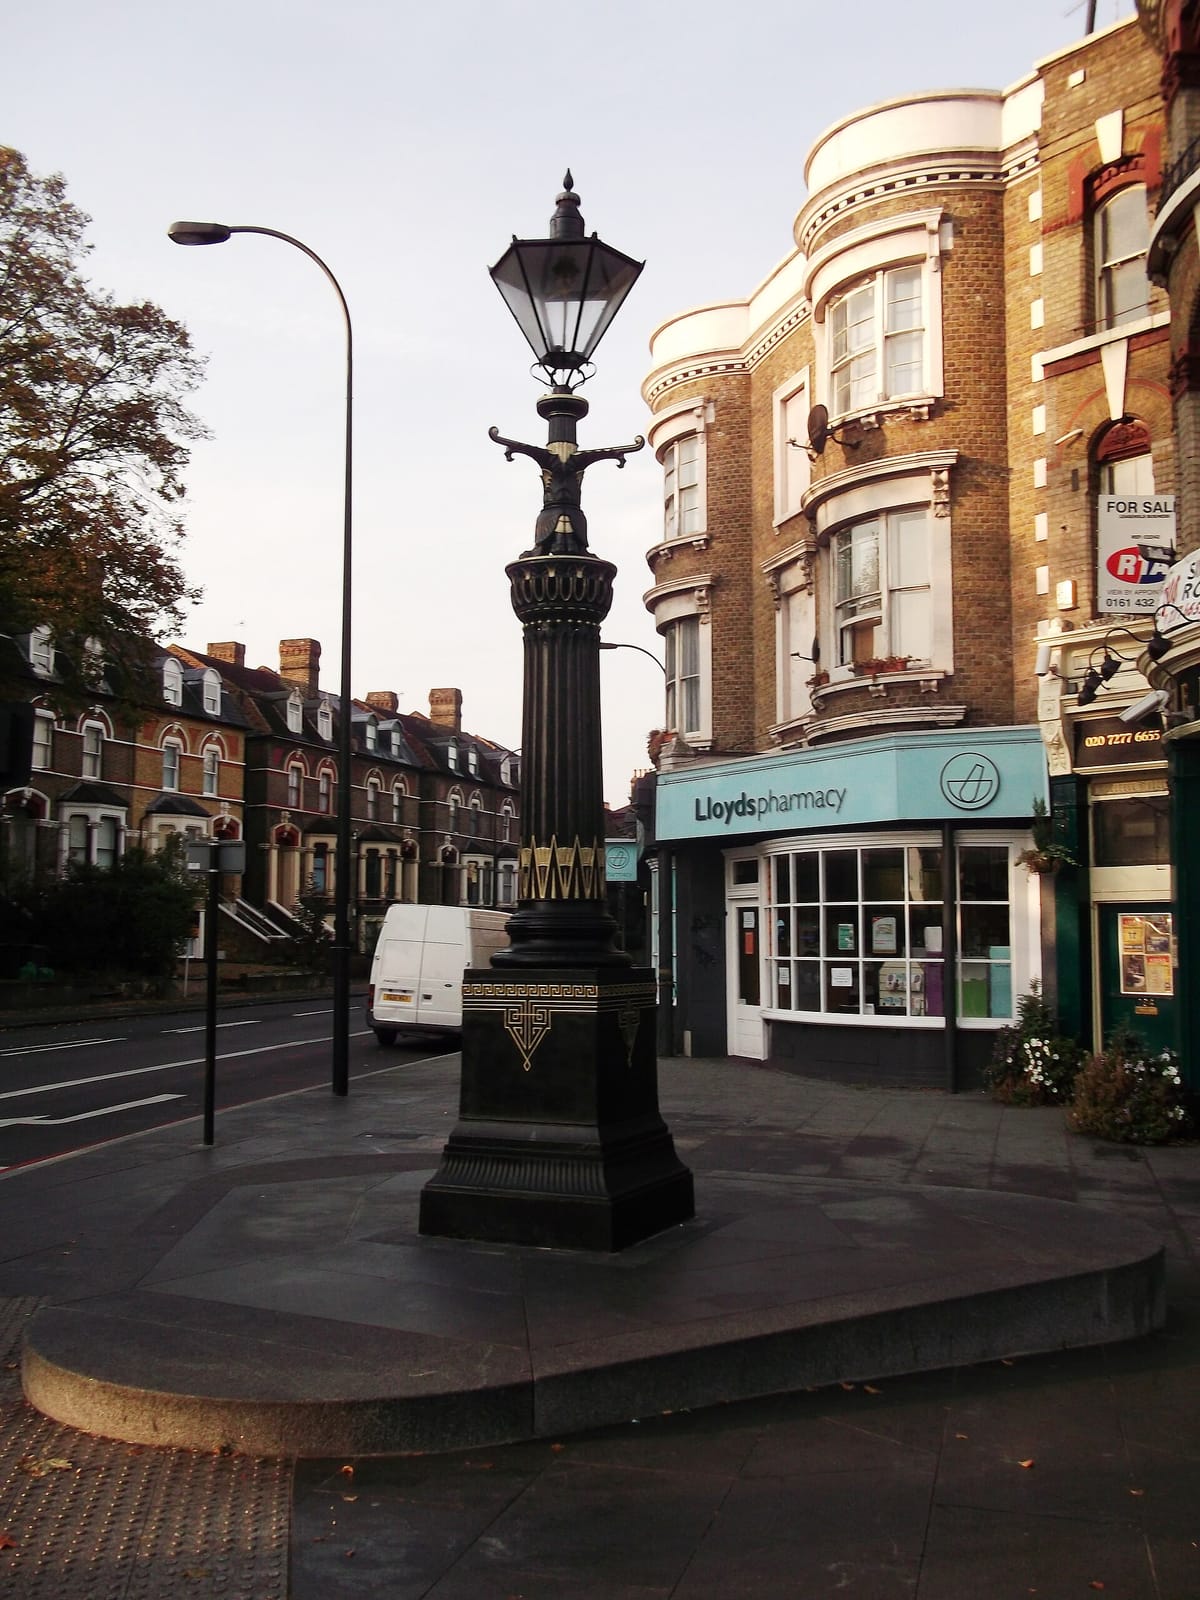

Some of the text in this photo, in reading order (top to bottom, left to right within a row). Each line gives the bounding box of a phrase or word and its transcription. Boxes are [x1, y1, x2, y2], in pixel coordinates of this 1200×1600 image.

[1107, 501, 1137, 513] FOR
[1106, 598, 1156, 607] 0161 432
[1085, 730, 1161, 748] 020 7277 6655
[695, 788, 847, 825] Lloydspharmacy
